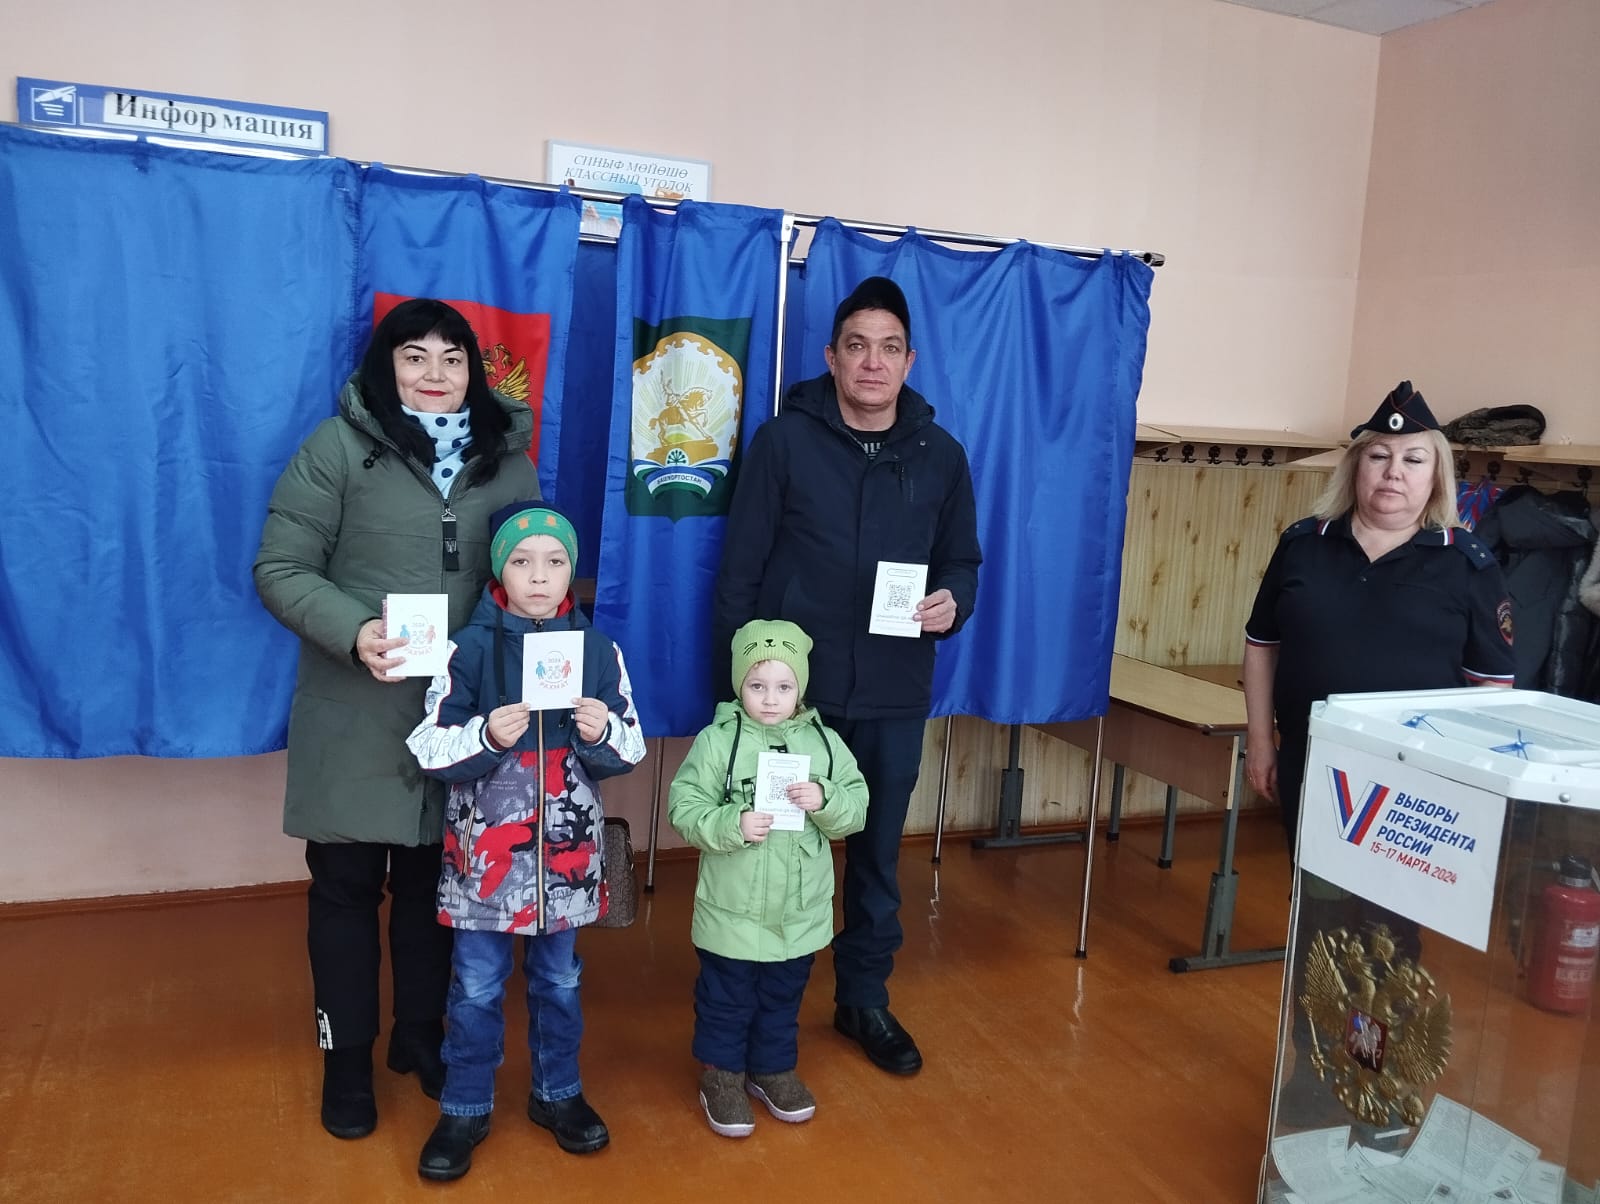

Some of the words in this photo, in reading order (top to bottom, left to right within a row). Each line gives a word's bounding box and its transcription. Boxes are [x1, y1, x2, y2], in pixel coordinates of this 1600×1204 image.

[565, 167, 642, 186] КЛАССНЫЙ
[643, 177, 694, 193] УГОЛОК
[1394, 792, 1460, 825] ВЫБОРЫ
[1377, 825, 1434, 857] РОССИИ
[1385, 809, 1477, 853] ПРЕЗИДЕНТА
[1396, 854, 1431, 875] МАРТА
[1431, 866, 1458, 885] 2024
